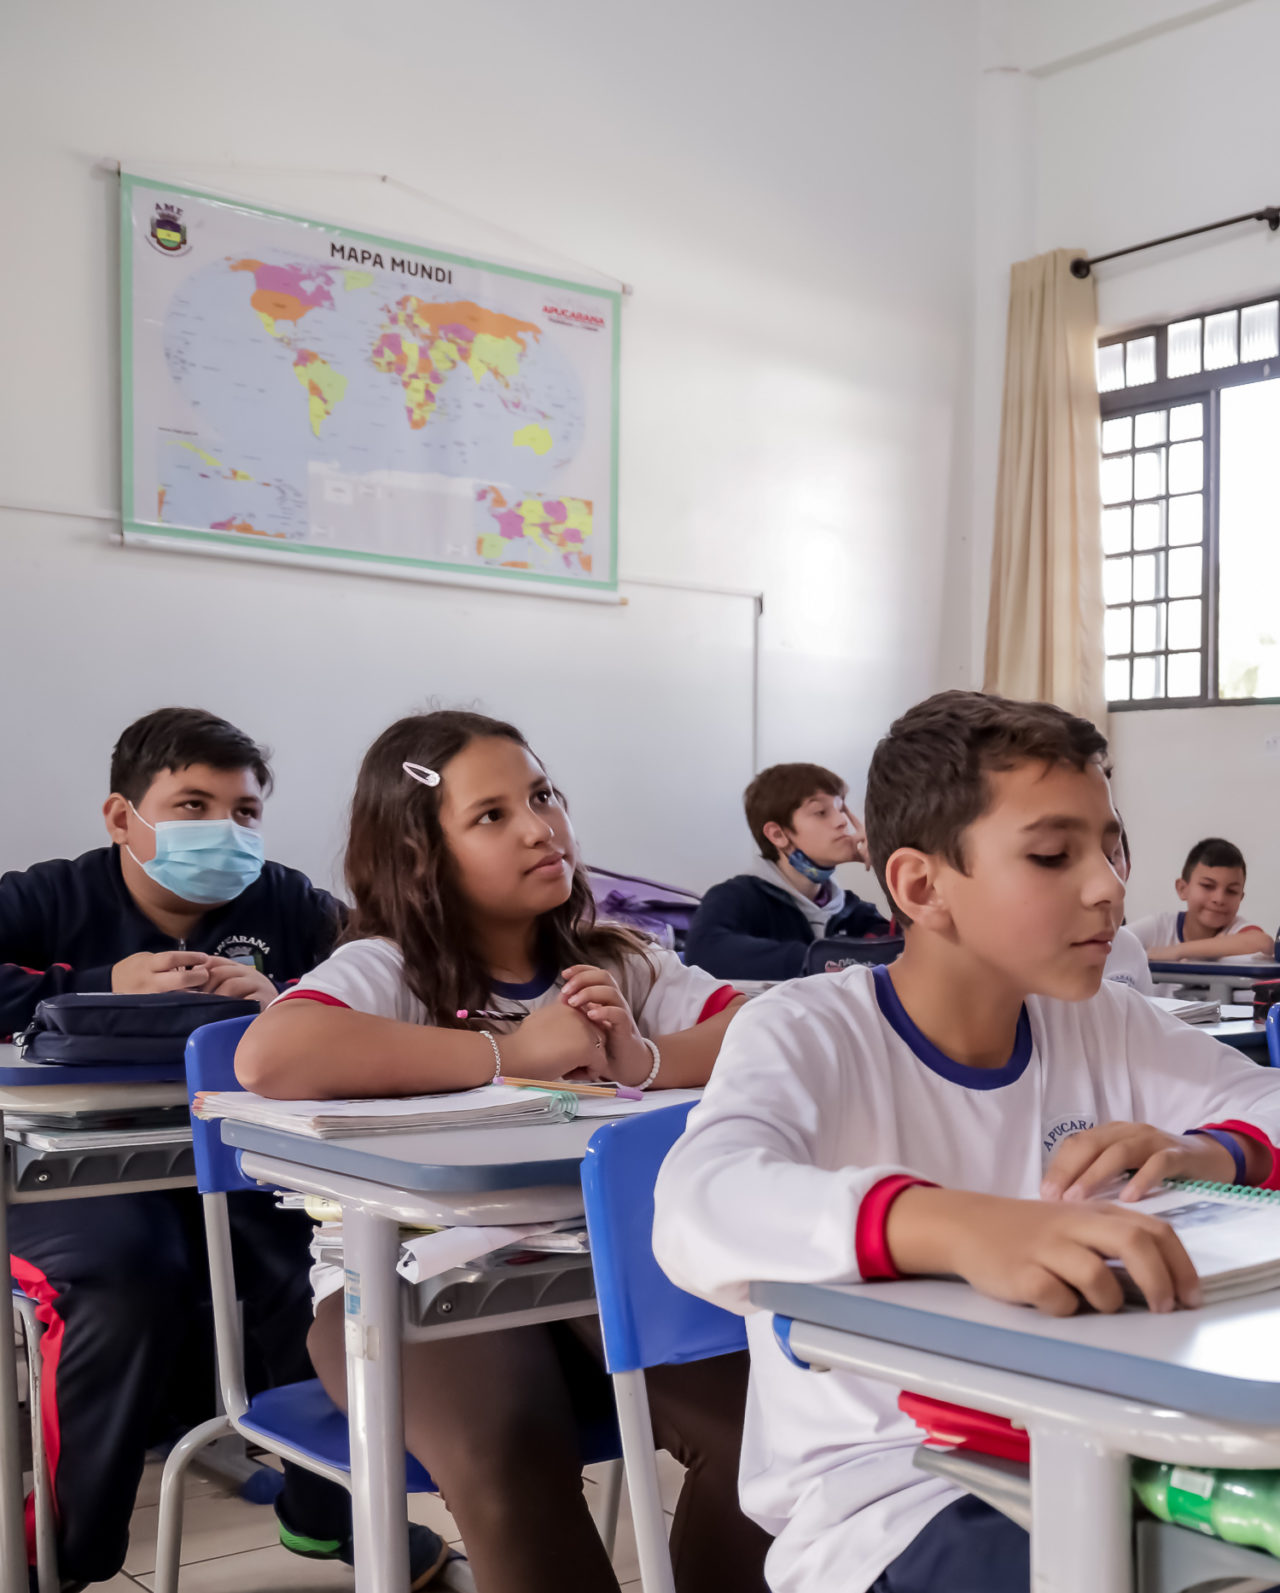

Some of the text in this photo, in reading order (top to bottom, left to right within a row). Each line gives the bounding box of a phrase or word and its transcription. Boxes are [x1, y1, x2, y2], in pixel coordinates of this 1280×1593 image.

[330, 242, 452, 284] MAPA MUNDI
[213, 935, 270, 955] PUCARANA
